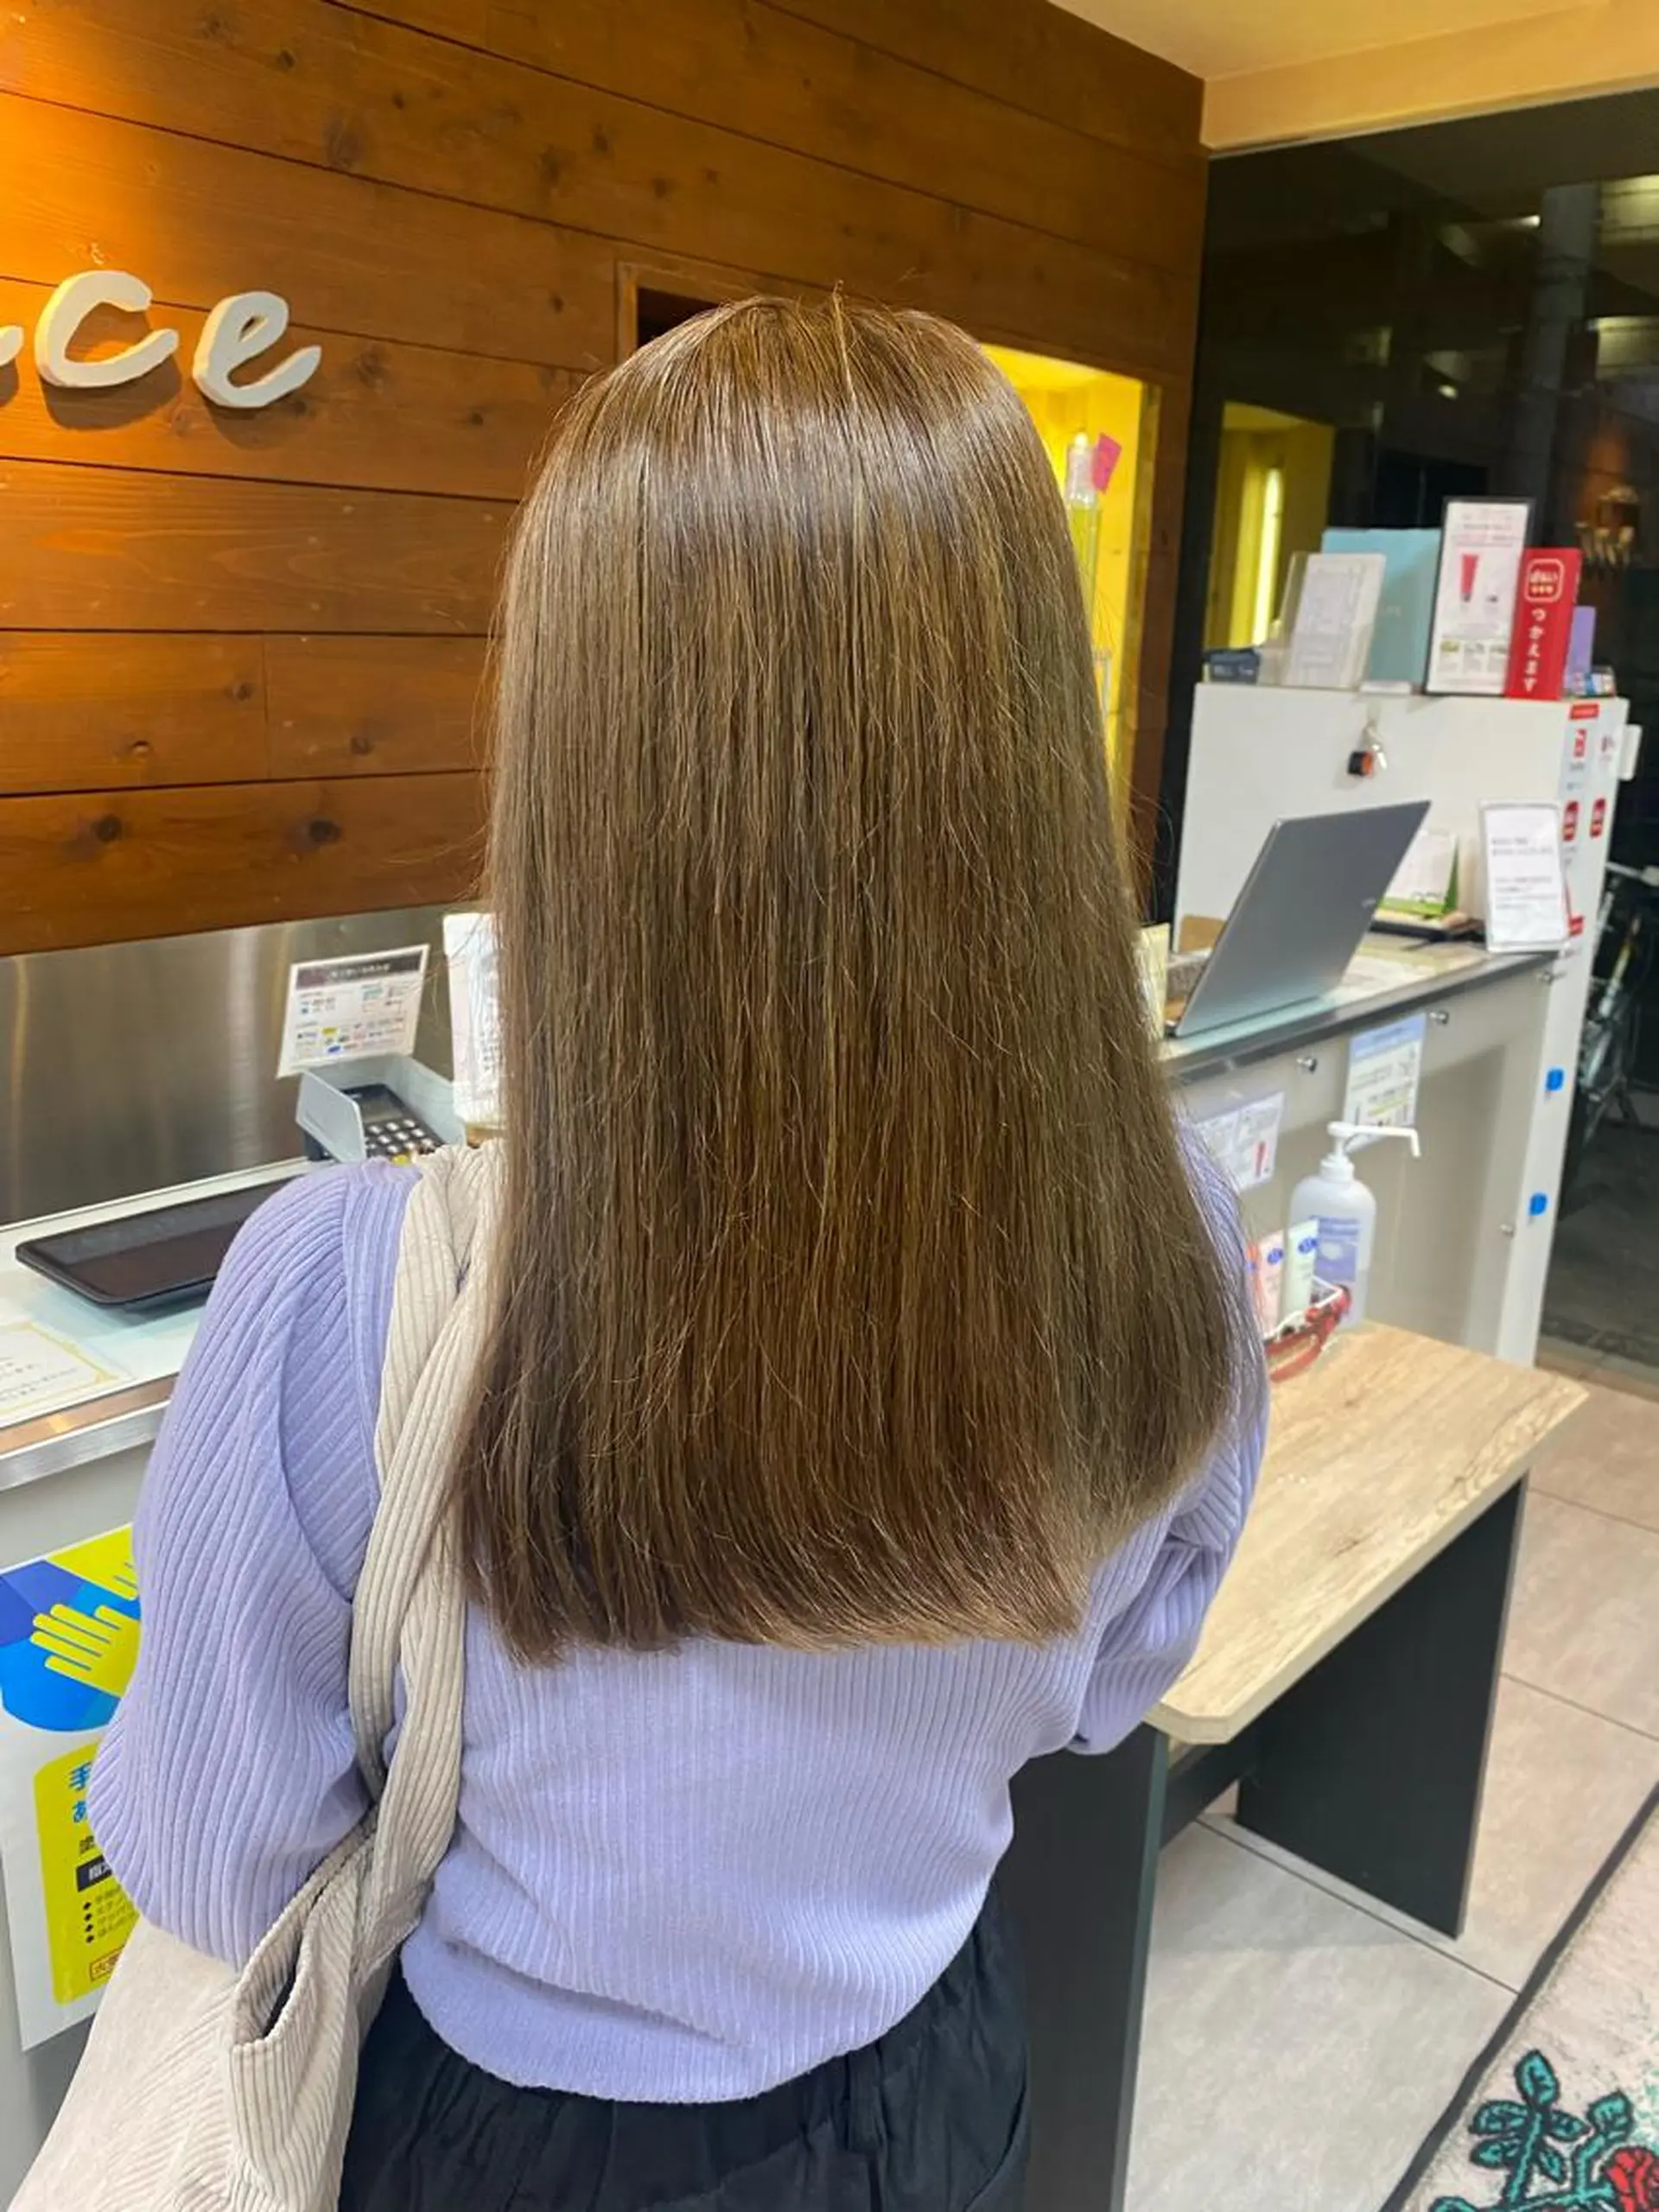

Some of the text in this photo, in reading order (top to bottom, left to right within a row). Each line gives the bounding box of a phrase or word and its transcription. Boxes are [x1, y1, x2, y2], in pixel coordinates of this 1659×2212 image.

[0, 270, 322, 409] ce
[1523, 608, 1548, 692] つかえます
